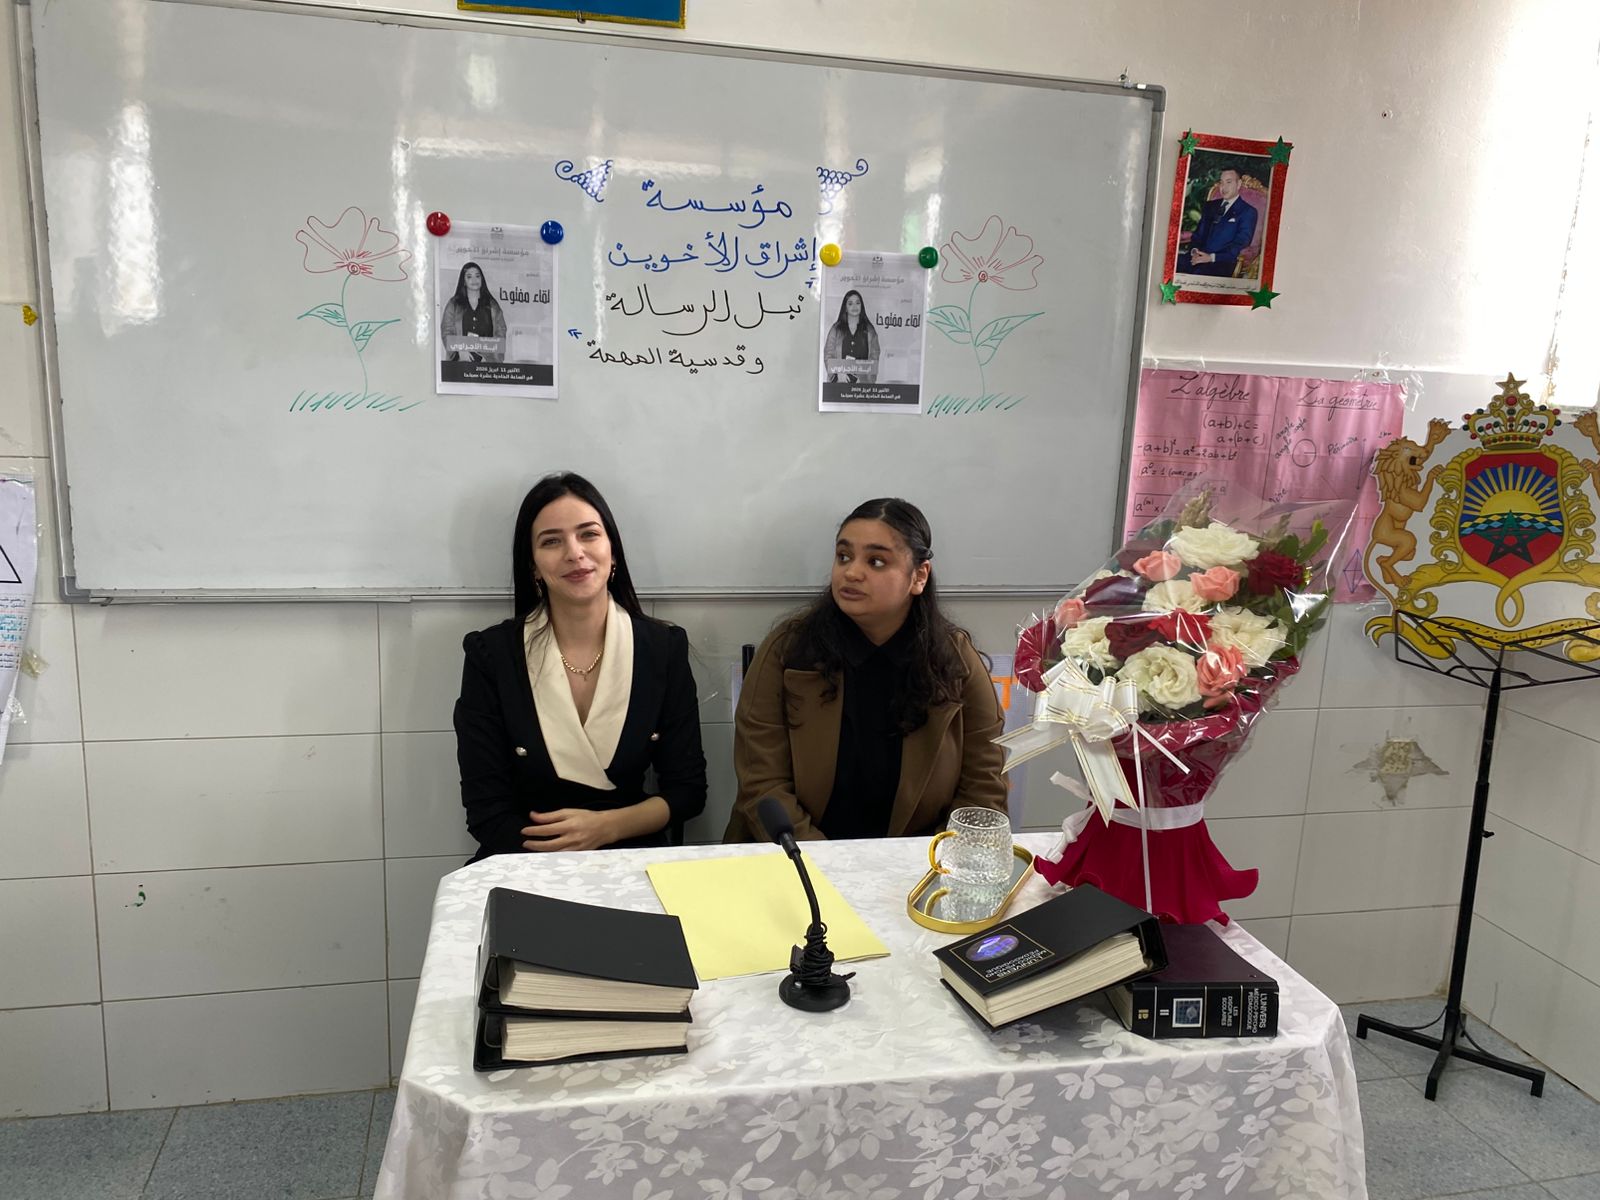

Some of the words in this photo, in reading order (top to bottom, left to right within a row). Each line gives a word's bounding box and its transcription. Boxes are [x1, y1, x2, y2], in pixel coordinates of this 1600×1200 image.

[642, 180, 792, 229] مؤسسة
[745, 237, 817, 278] إشراق
[606, 283, 731, 336] الرسالة
[734, 292, 804, 329] نبل
[587, 340, 662, 366] المهمة
[1259, 993, 1268, 1028] L'UNIVERS
